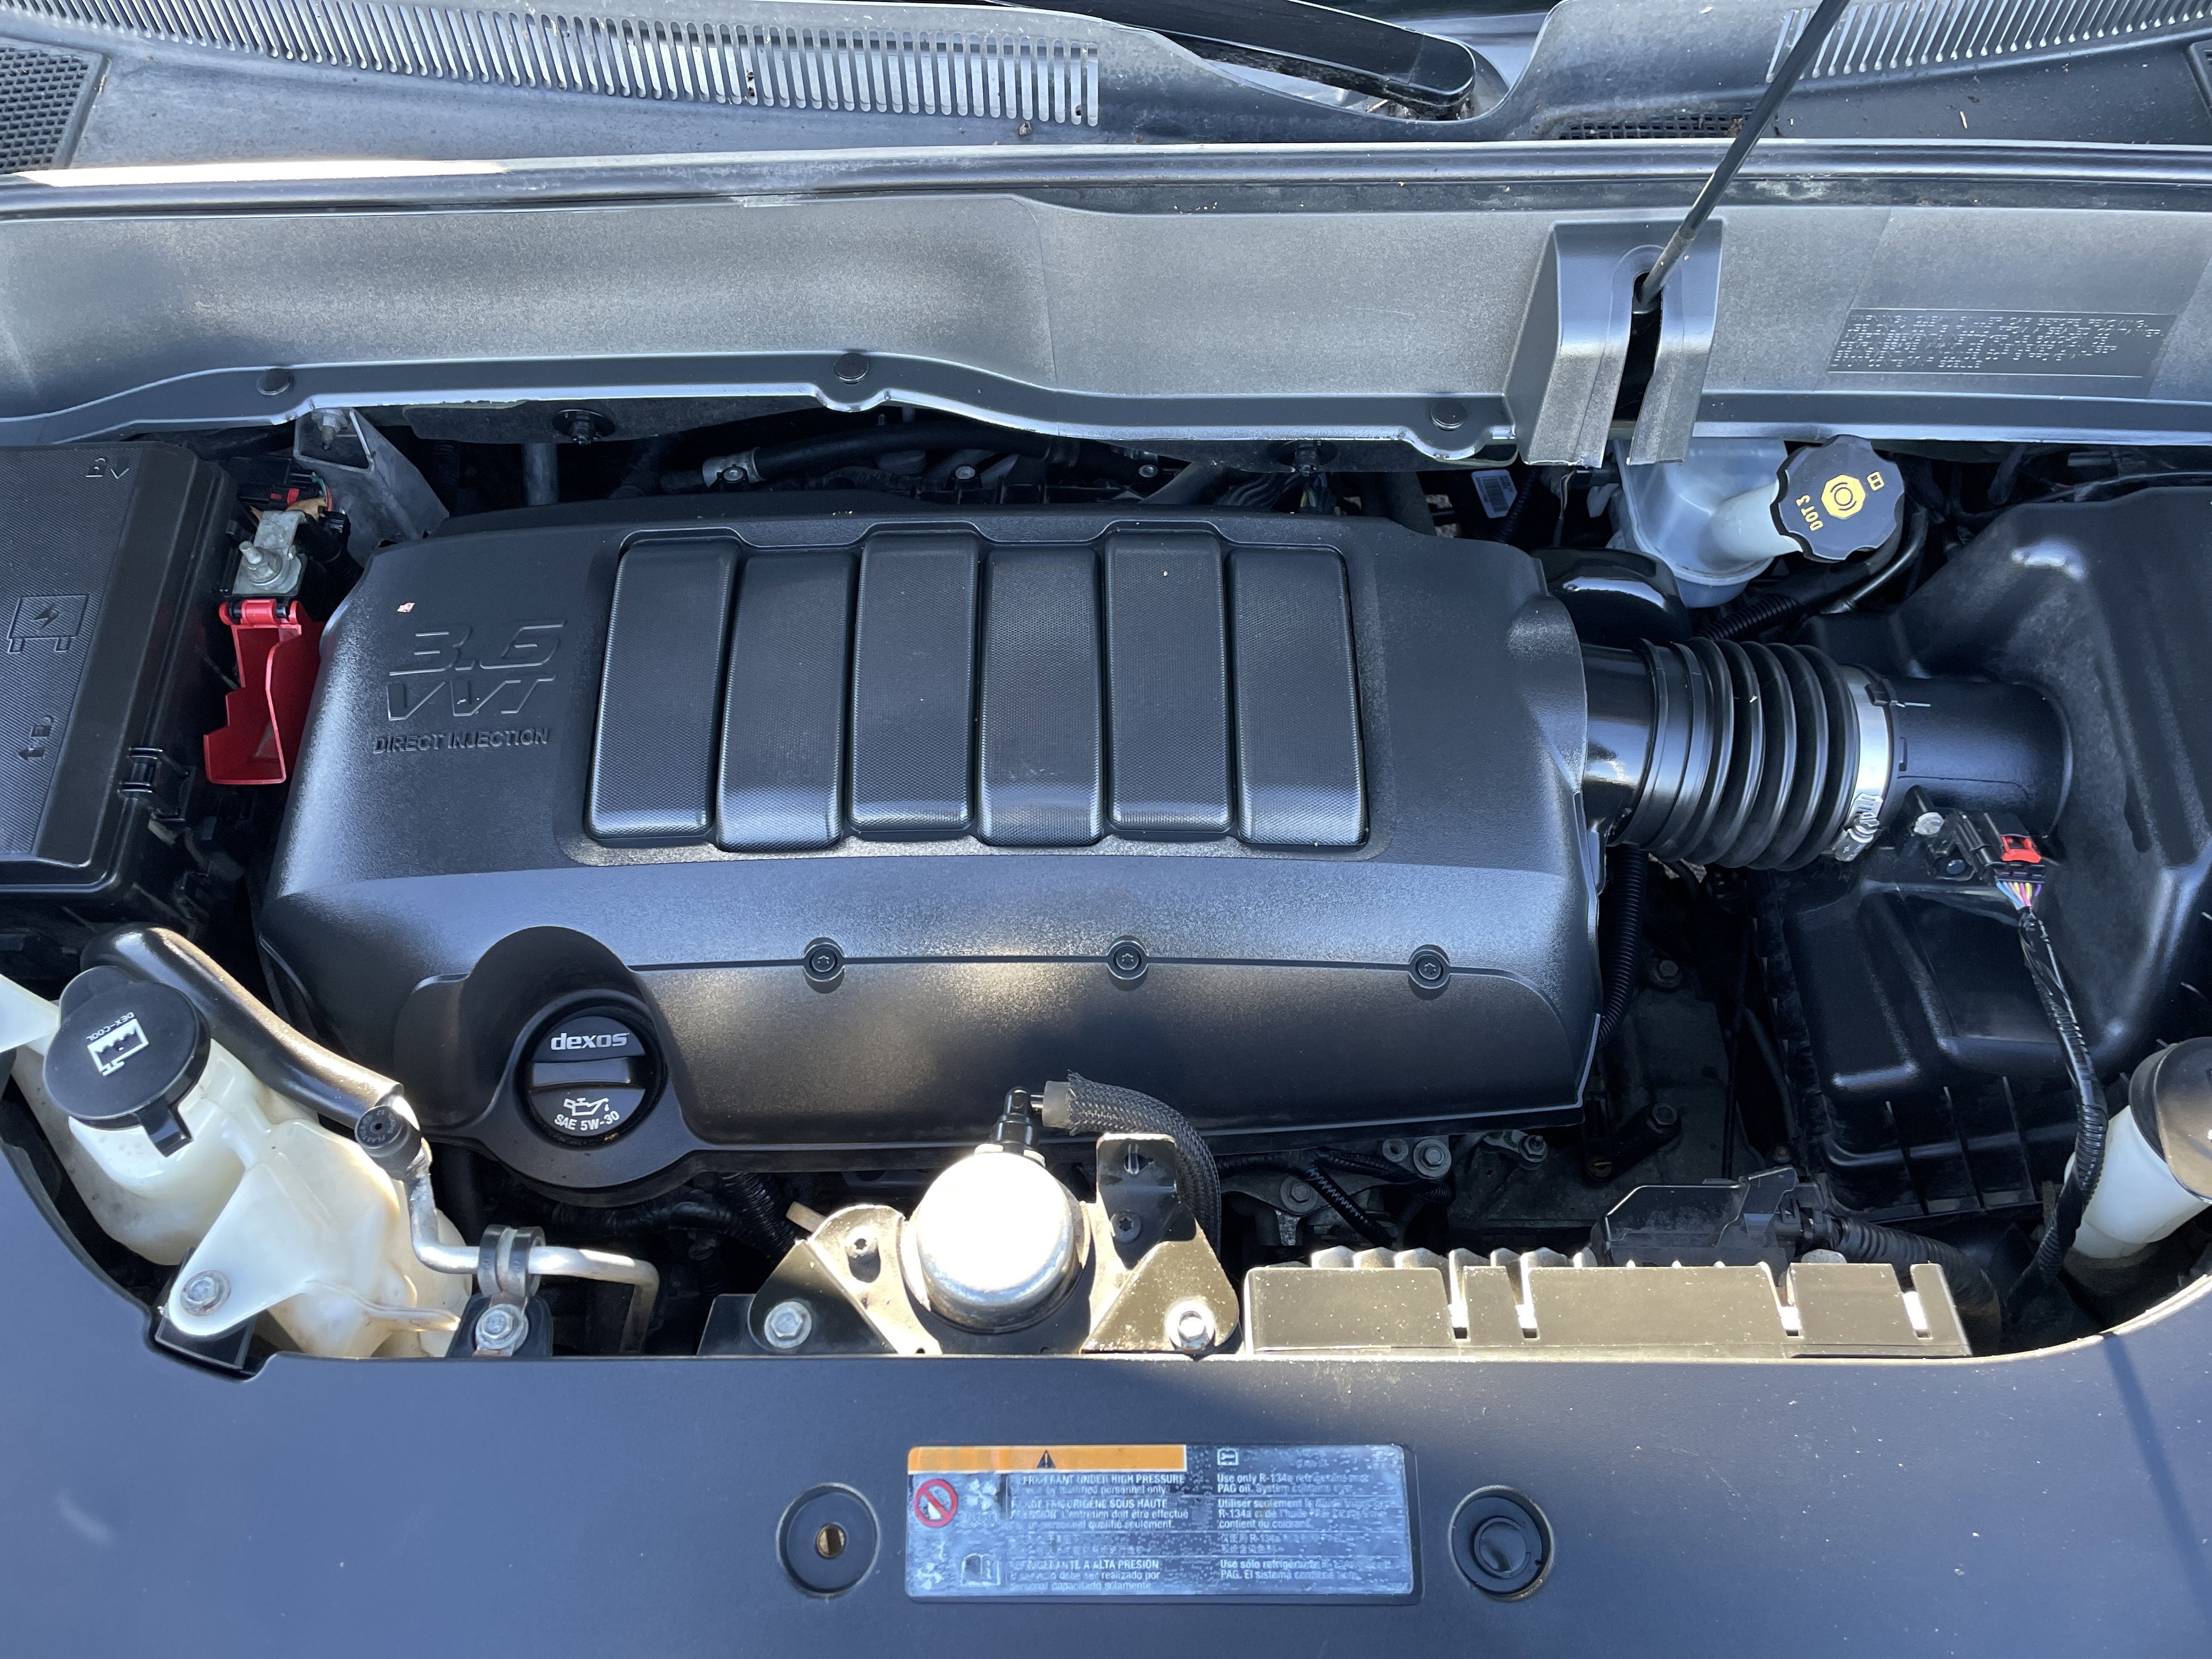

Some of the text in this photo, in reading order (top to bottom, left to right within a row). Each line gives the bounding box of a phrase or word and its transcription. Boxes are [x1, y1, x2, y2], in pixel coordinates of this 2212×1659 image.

[1796, 495, 1824, 532] DOT 3
[389, 619, 565, 676] 3.6
[386, 674, 556, 721] VVT
[373, 727, 551, 754] DIRECT INJECTION
[86, 1012, 136, 1041] DEX-COOL
[550, 1032, 629, 1051] dexos
[554, 1110, 620, 1131] SAE 5W-30
[1111, 1474, 1134, 1484] HIGH
[1136, 1473, 1186, 1484] PRESSURE
[1217, 1473, 1235, 1483] Use
[1237, 1473, 1257, 1486] only
[1259, 1472, 1293, 1483] R-134a
[1217, 1483, 1237, 1493] PAG
[1109, 1498, 1135, 1508] SOUS
[1137, 1498, 1168, 1509] HAUTE
[1218, 1498, 1251, 1508] Utiliser
[1253, 1498, 1302, 1508] seulement
[1152, 1509, 1189, 1519] effectué
[1218, 1509, 1252, 1519] R-134a
[1218, 1520, 1256, 1530] contient
[1083, 1560, 1091, 1570] A
[1092, 1559, 1116, 1570] ALTA
[1220, 1559, 1238, 1569] Use
[1101, 1571, 1143, 1580] realizado
[1145, 1572, 1160, 1582] por
[1221, 1569, 1242, 1579] PAG.
[1244, 1570, 1254, 1579] El
